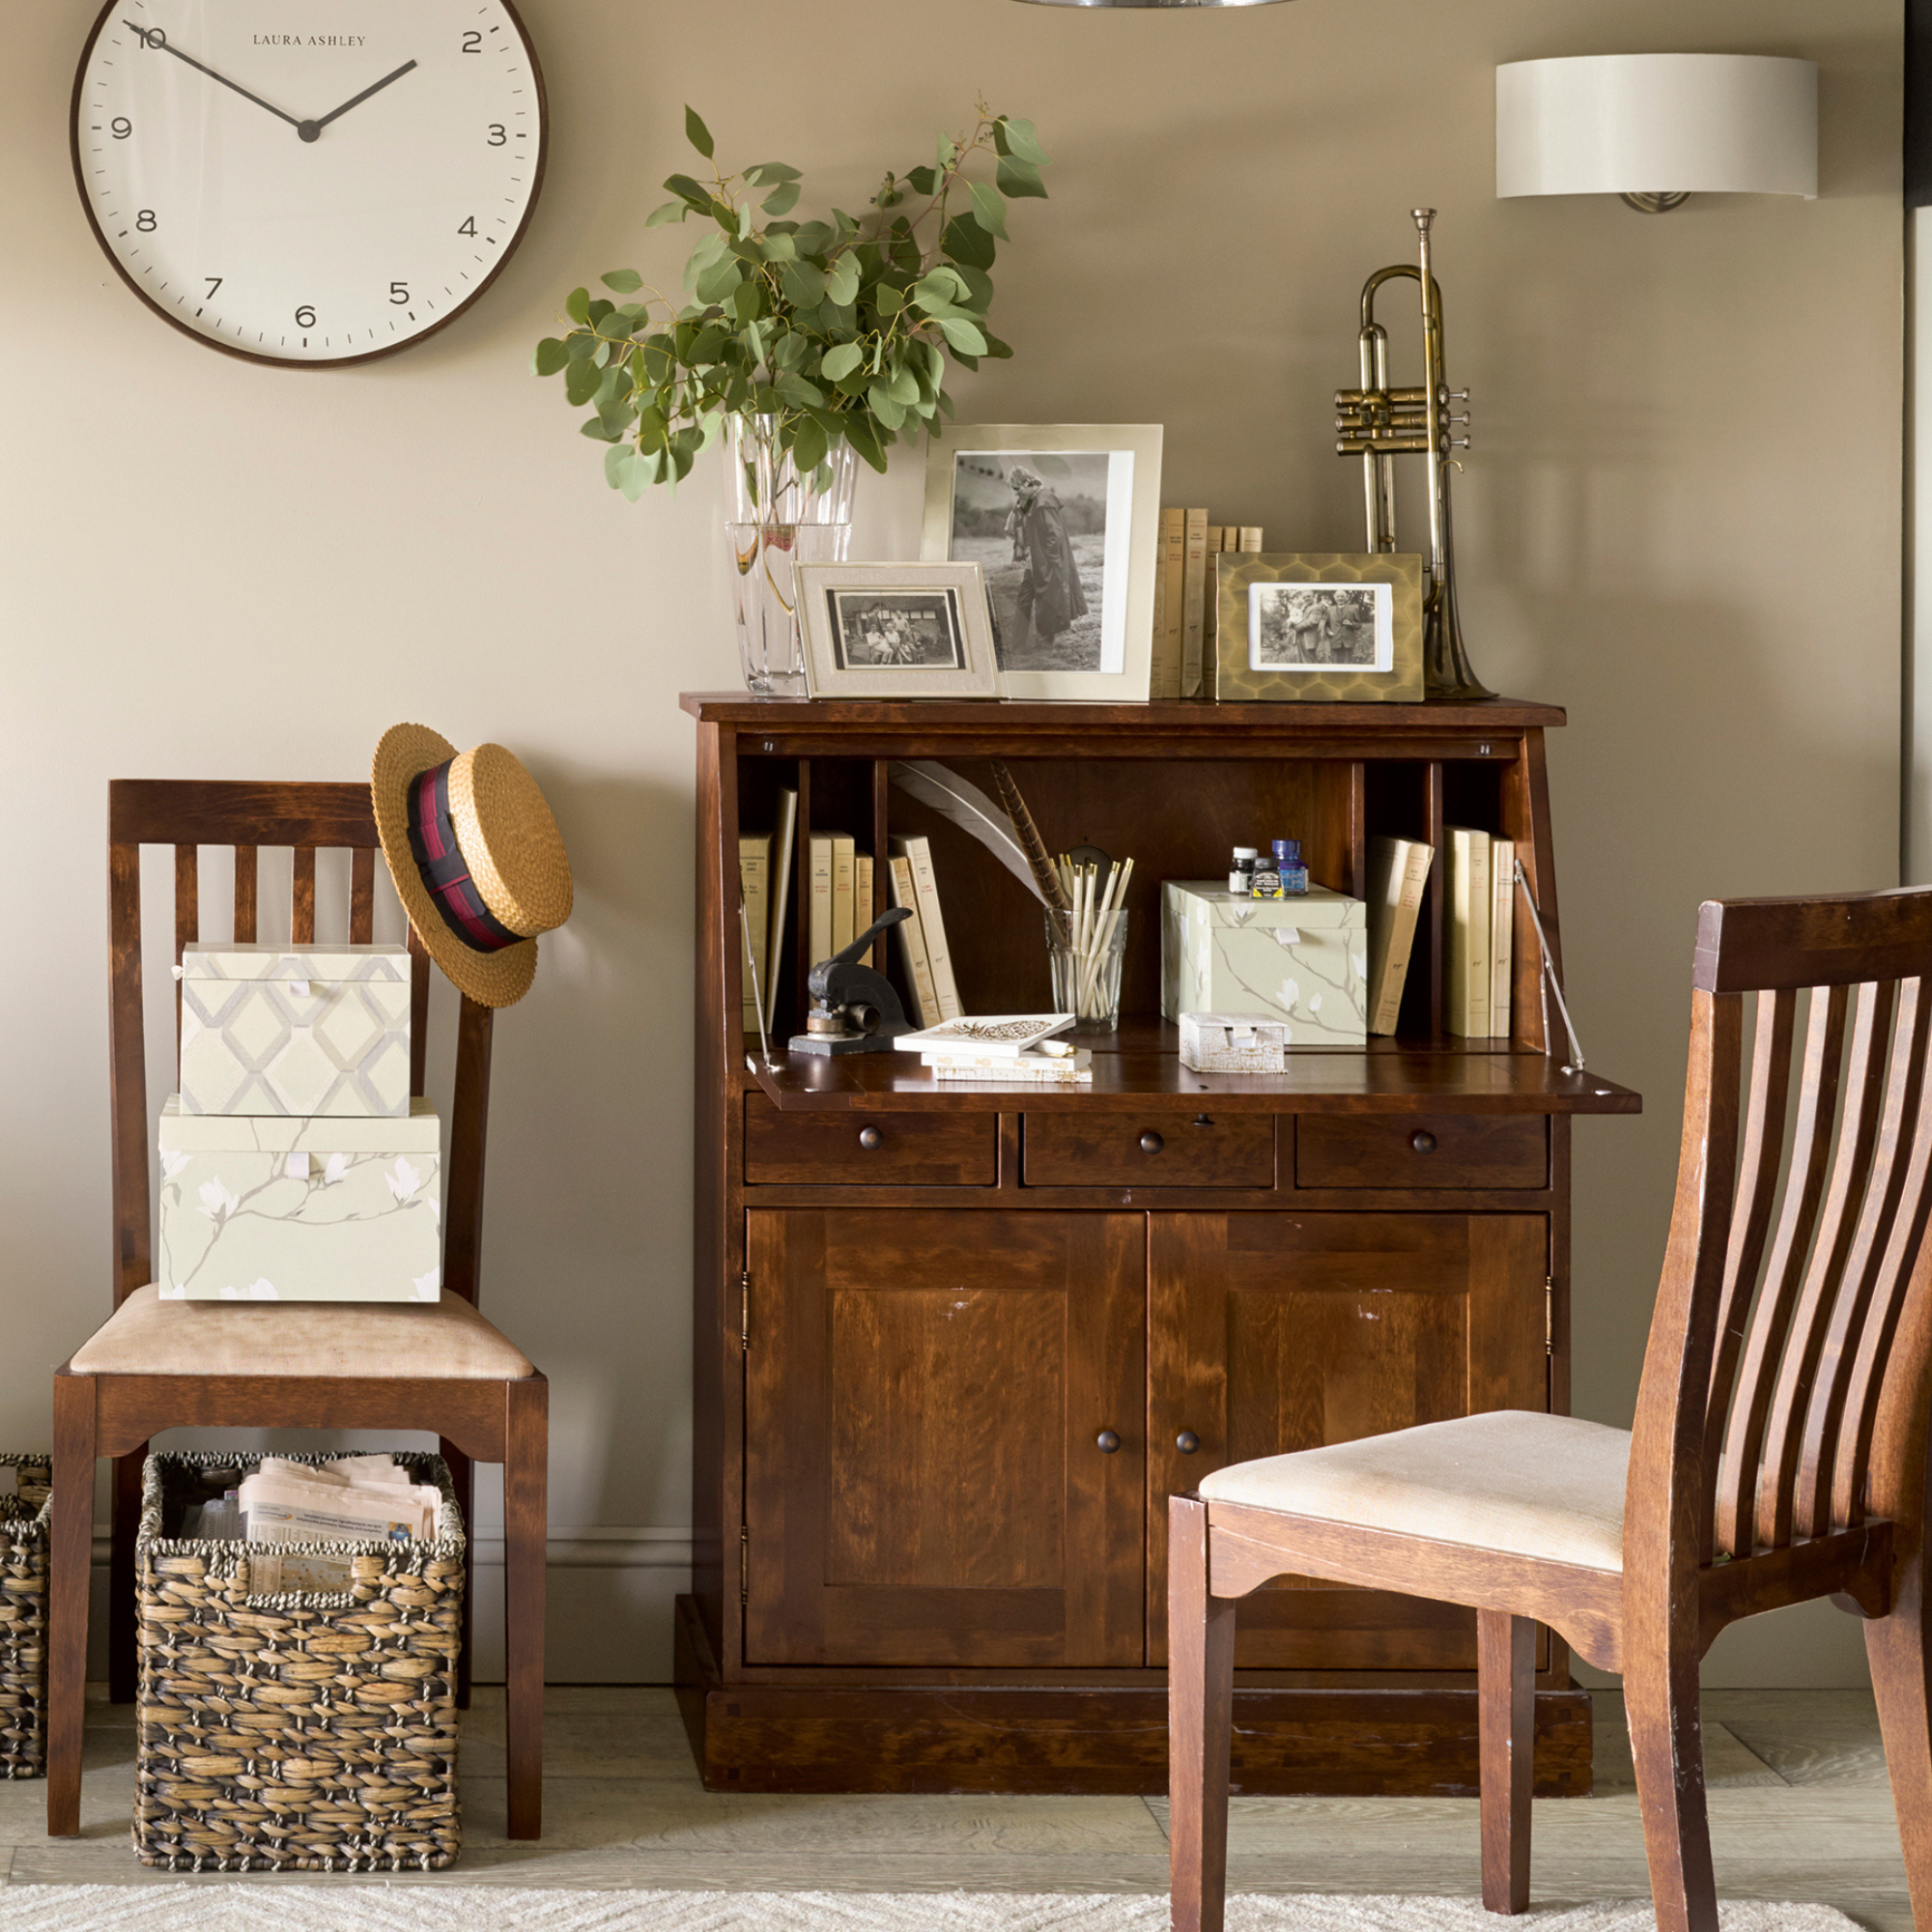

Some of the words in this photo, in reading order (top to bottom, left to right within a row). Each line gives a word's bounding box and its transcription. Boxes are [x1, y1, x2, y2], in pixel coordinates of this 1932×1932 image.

[139, 27, 167, 50] 10
[253, 34, 301, 45] LAURA
[307, 35, 366, 46] ASHLEY
[462, 31, 483, 53] 2
[110, 117, 132, 140] 9
[487, 124, 507, 147] 3
[135, 209, 157, 233] 8
[457, 215, 478, 239] 4
[204, 277, 223, 300] 7
[388, 281, 411, 305] 5
[295, 304, 317, 328] 6
